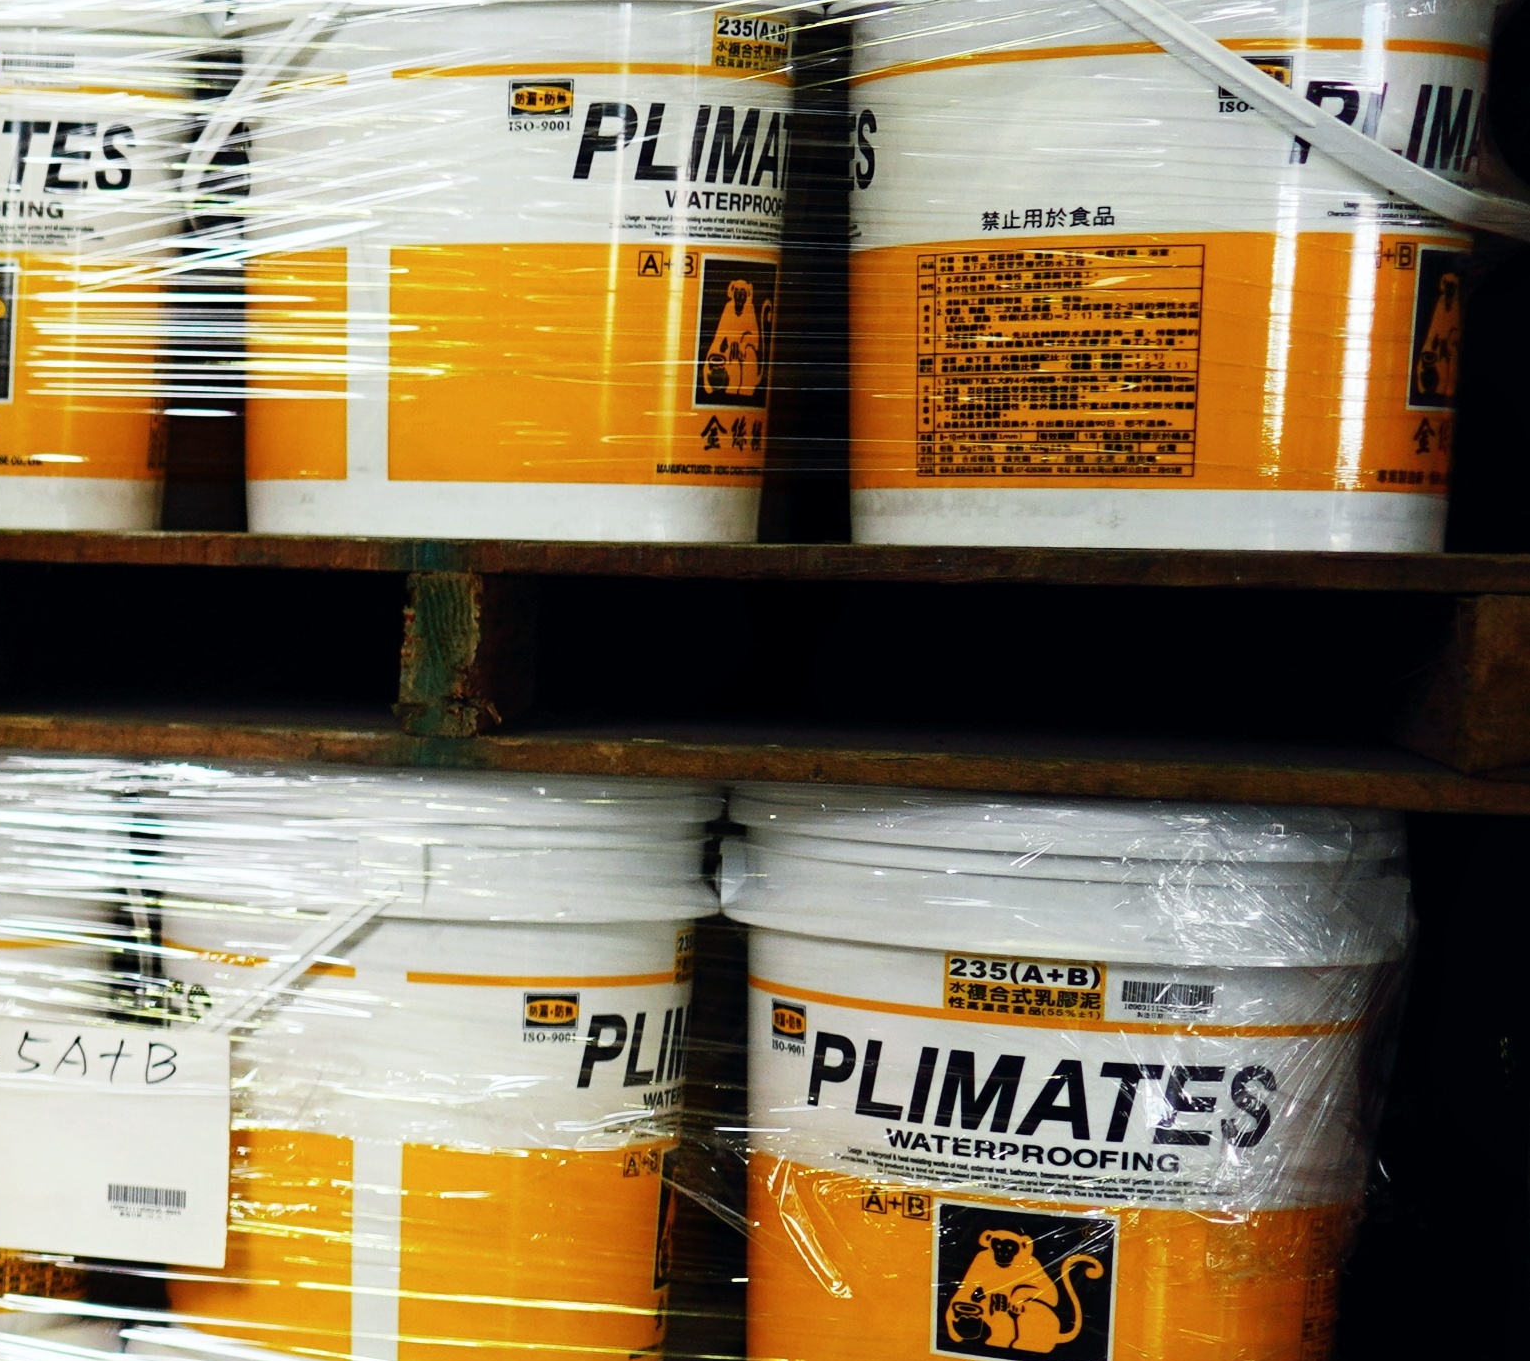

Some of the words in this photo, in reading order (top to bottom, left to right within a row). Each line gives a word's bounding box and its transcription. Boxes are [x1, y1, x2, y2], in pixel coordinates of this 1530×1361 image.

[509, 121, 571, 132] ISO-9001
[981, 206, 1115, 231] 禁止用於食品
[949, 958, 1101, 988] 235(A+B)
[806, 1031, 1277, 1149] PLIMATES
[885, 1127, 1179, 1174] WATERPROOFING
